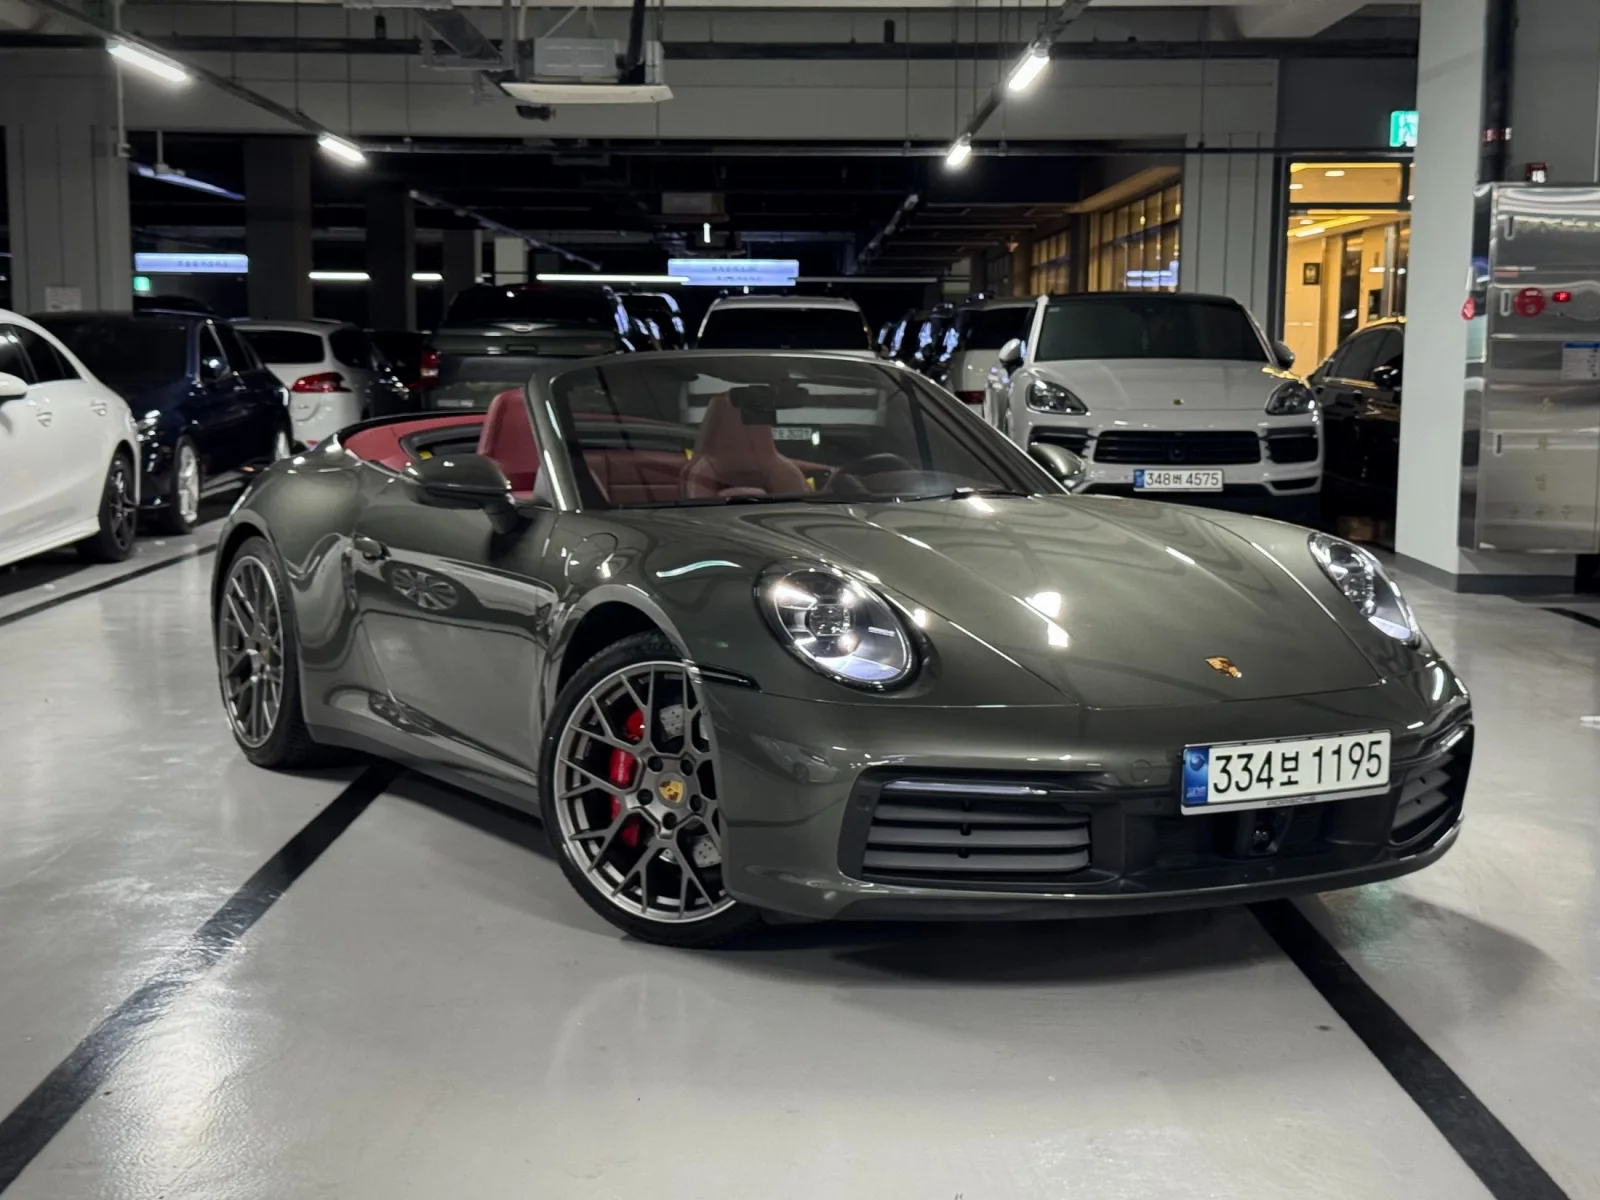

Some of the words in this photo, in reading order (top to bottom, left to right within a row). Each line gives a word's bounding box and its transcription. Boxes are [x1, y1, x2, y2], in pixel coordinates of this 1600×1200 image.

[1185, 472, 1219, 486] 4575
[1213, 750, 1300, 794] 334보
[1312, 740, 1382, 784] 1195
